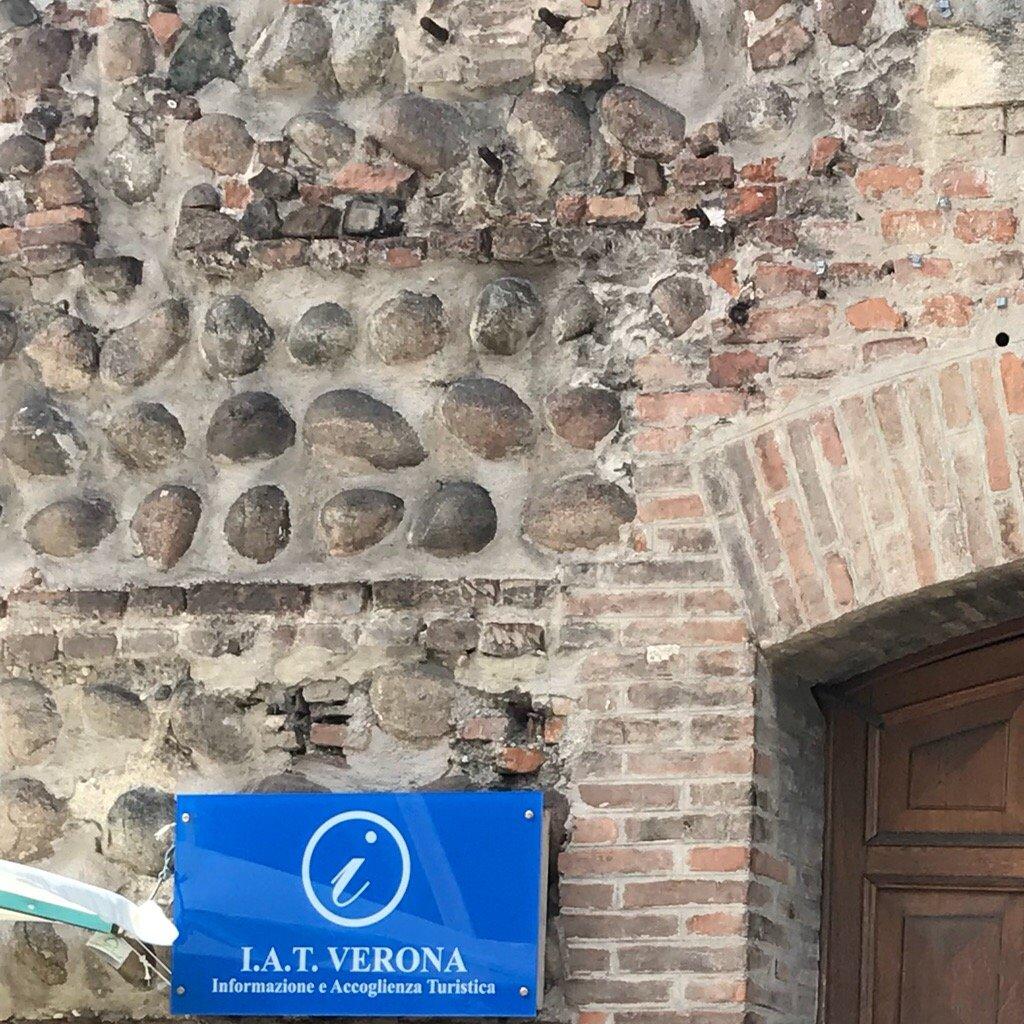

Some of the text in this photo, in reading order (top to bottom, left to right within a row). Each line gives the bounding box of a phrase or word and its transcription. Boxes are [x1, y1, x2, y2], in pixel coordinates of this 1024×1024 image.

[240, 946, 468, 973] I.A.T. VERONA
[212, 977, 496, 997] Informazione e Accoglienza Turistica
